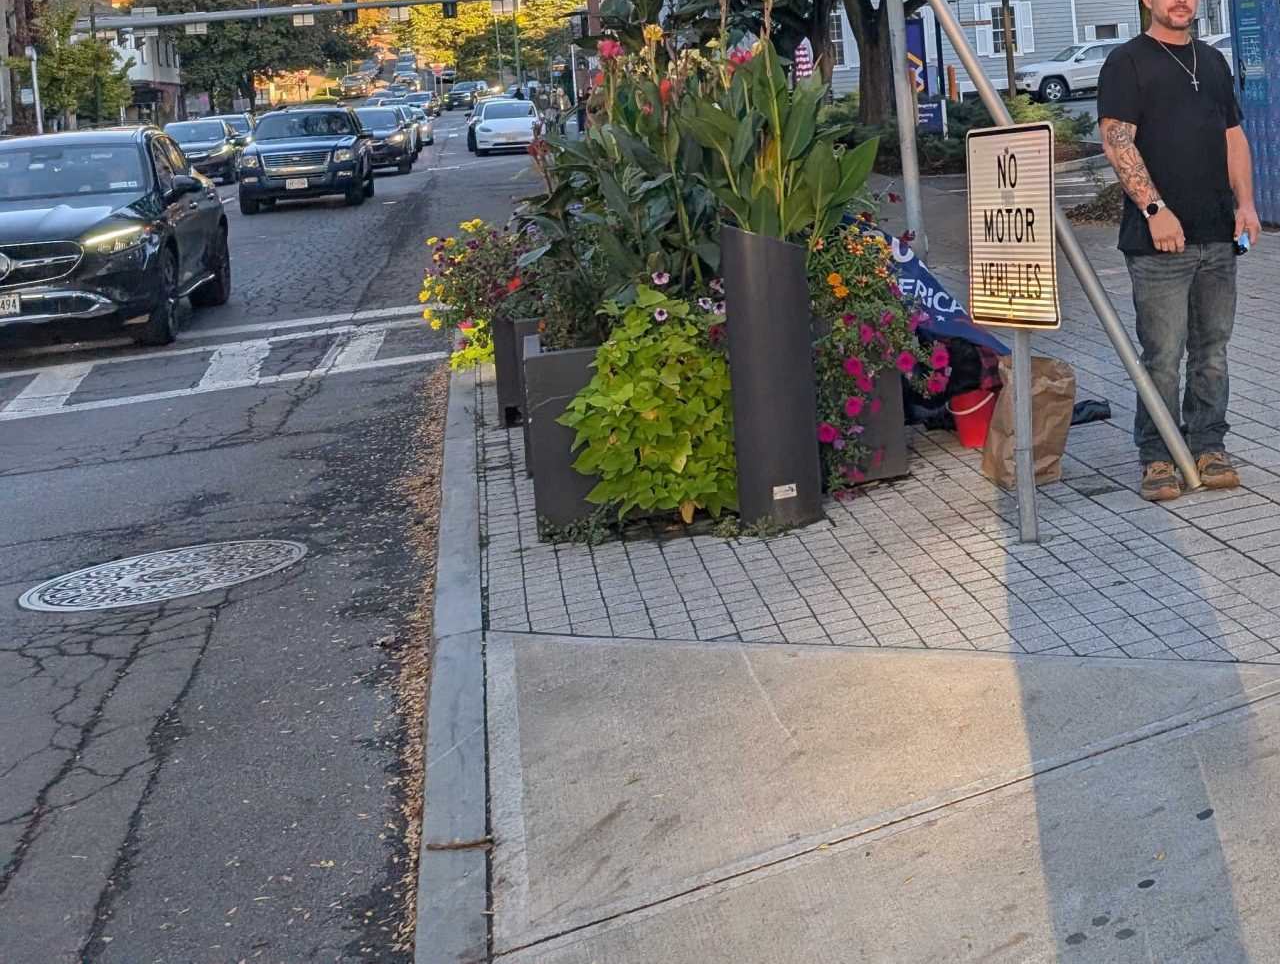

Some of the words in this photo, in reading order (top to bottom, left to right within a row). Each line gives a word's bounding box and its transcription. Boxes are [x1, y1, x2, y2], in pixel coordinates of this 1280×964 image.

[997, 153, 1017, 188] NO
[984, 208, 1035, 243] MOTOR
[898, 278, 968, 315] ERICA
